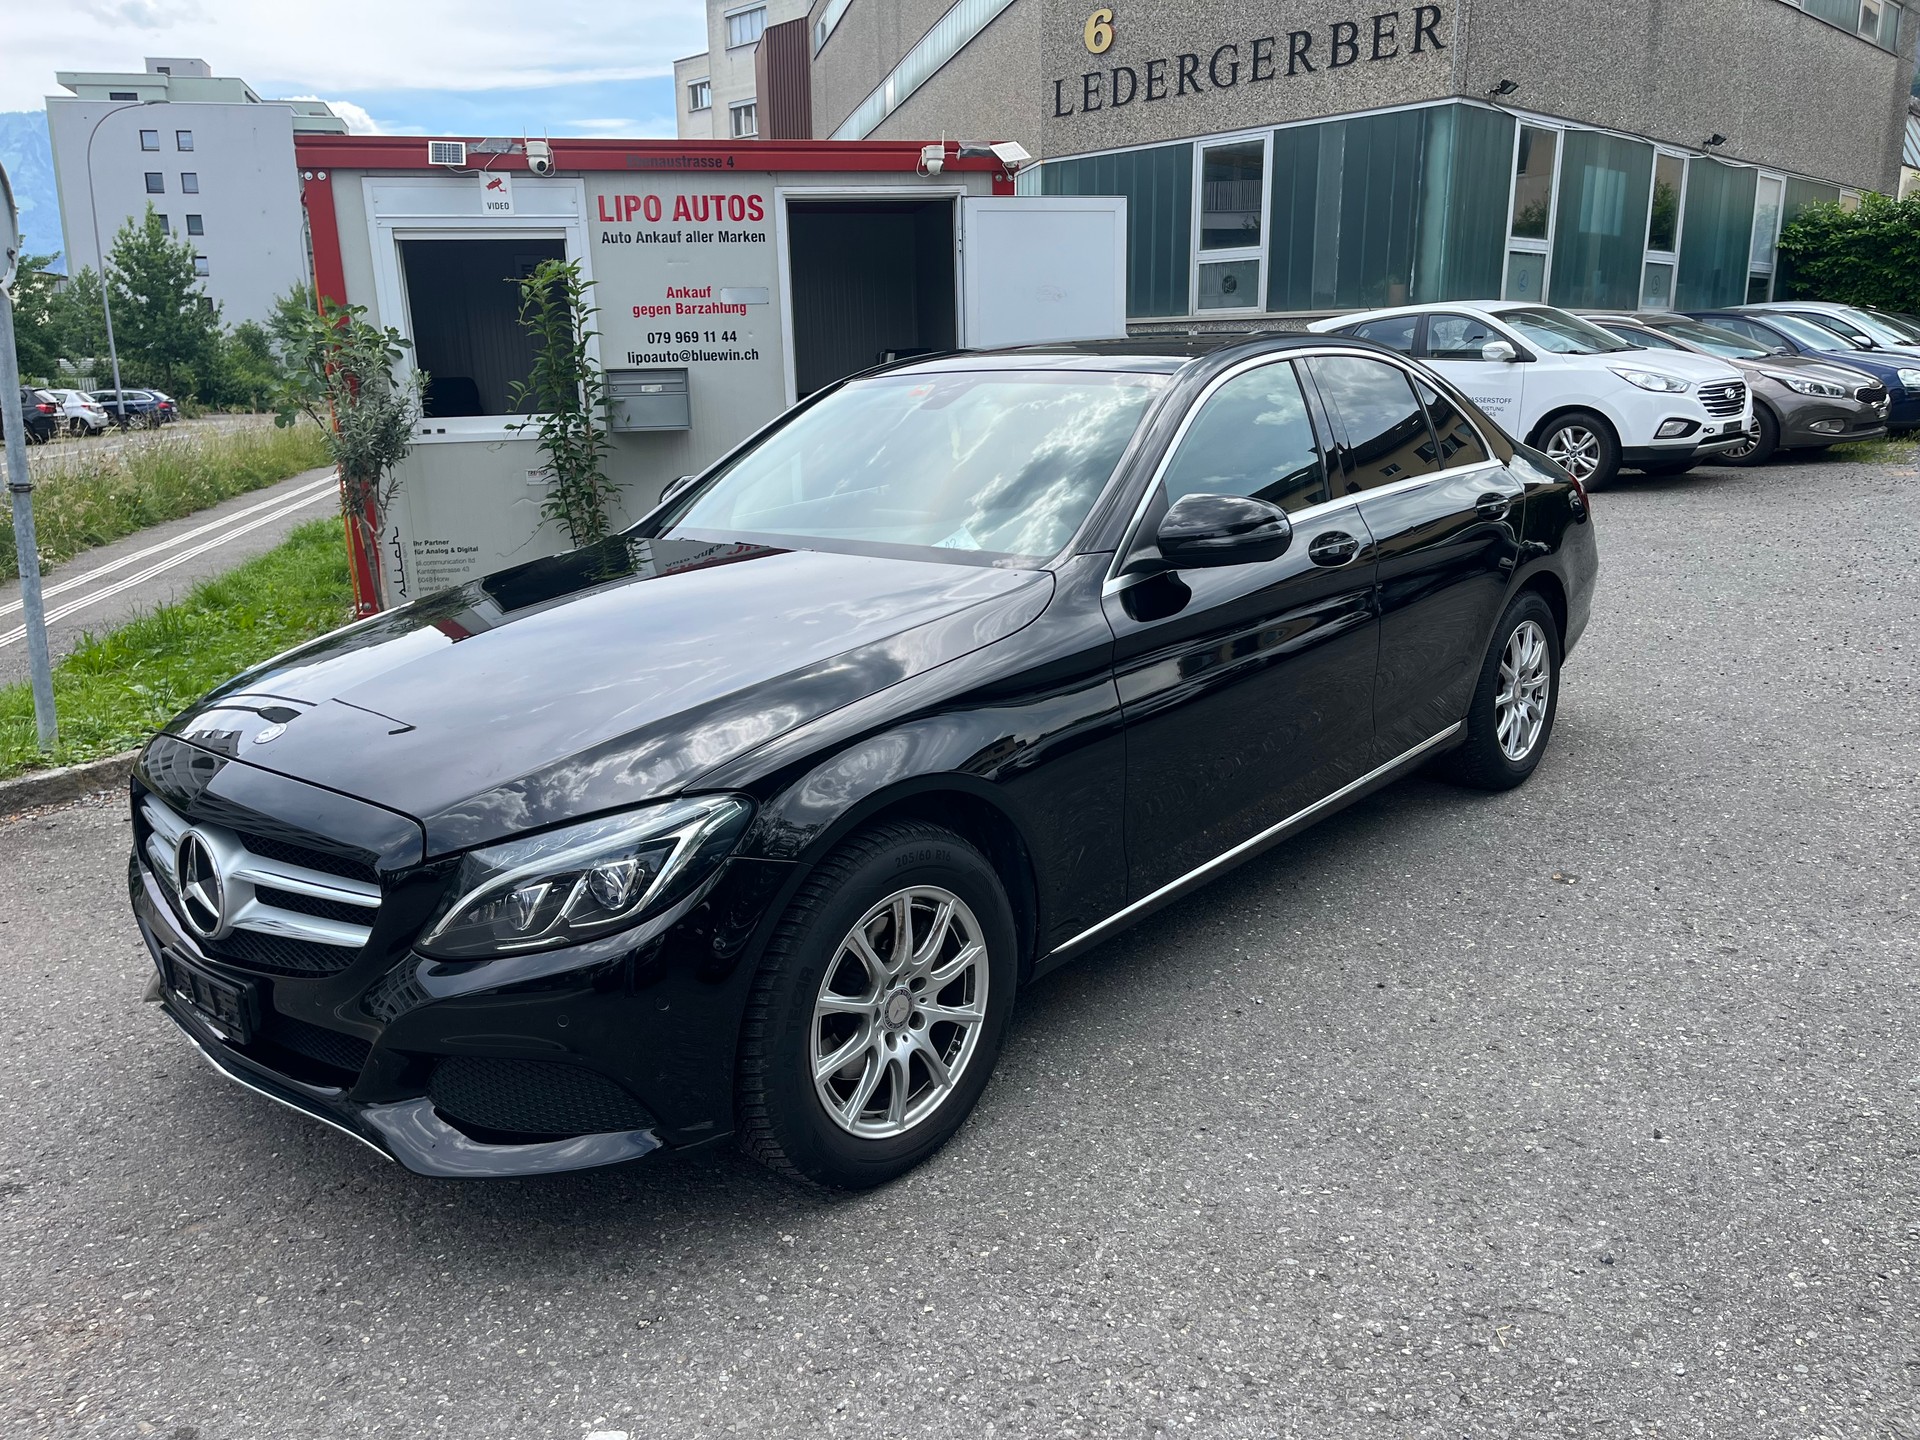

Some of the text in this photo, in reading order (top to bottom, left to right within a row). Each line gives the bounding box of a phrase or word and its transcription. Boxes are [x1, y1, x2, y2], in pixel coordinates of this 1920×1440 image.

[1084, 8, 1115, 55] 6
[1052, 4, 1447, 119] LEDERGERBER
[726, 155, 735, 168] 4
[486, 202, 510, 210] VIDEO
[597, 194, 765, 223] LIPO AUTOS
[601, 230, 766, 244] Auto Ankauf aller Marken
[666, 286, 712, 299] Ankauf
[632, 302, 747, 319] gegen Barzahlung
[647, 331, 738, 345] 079 969 11 44
[627, 348, 759, 366] lipoauto@bluewin.ch
[1469, 396, 1512, 404] ASSERSTOFF
[425, 547, 449, 555] Analog
[457, 546, 479, 554] Digital
[895, 849, 932, 869] 205/60
